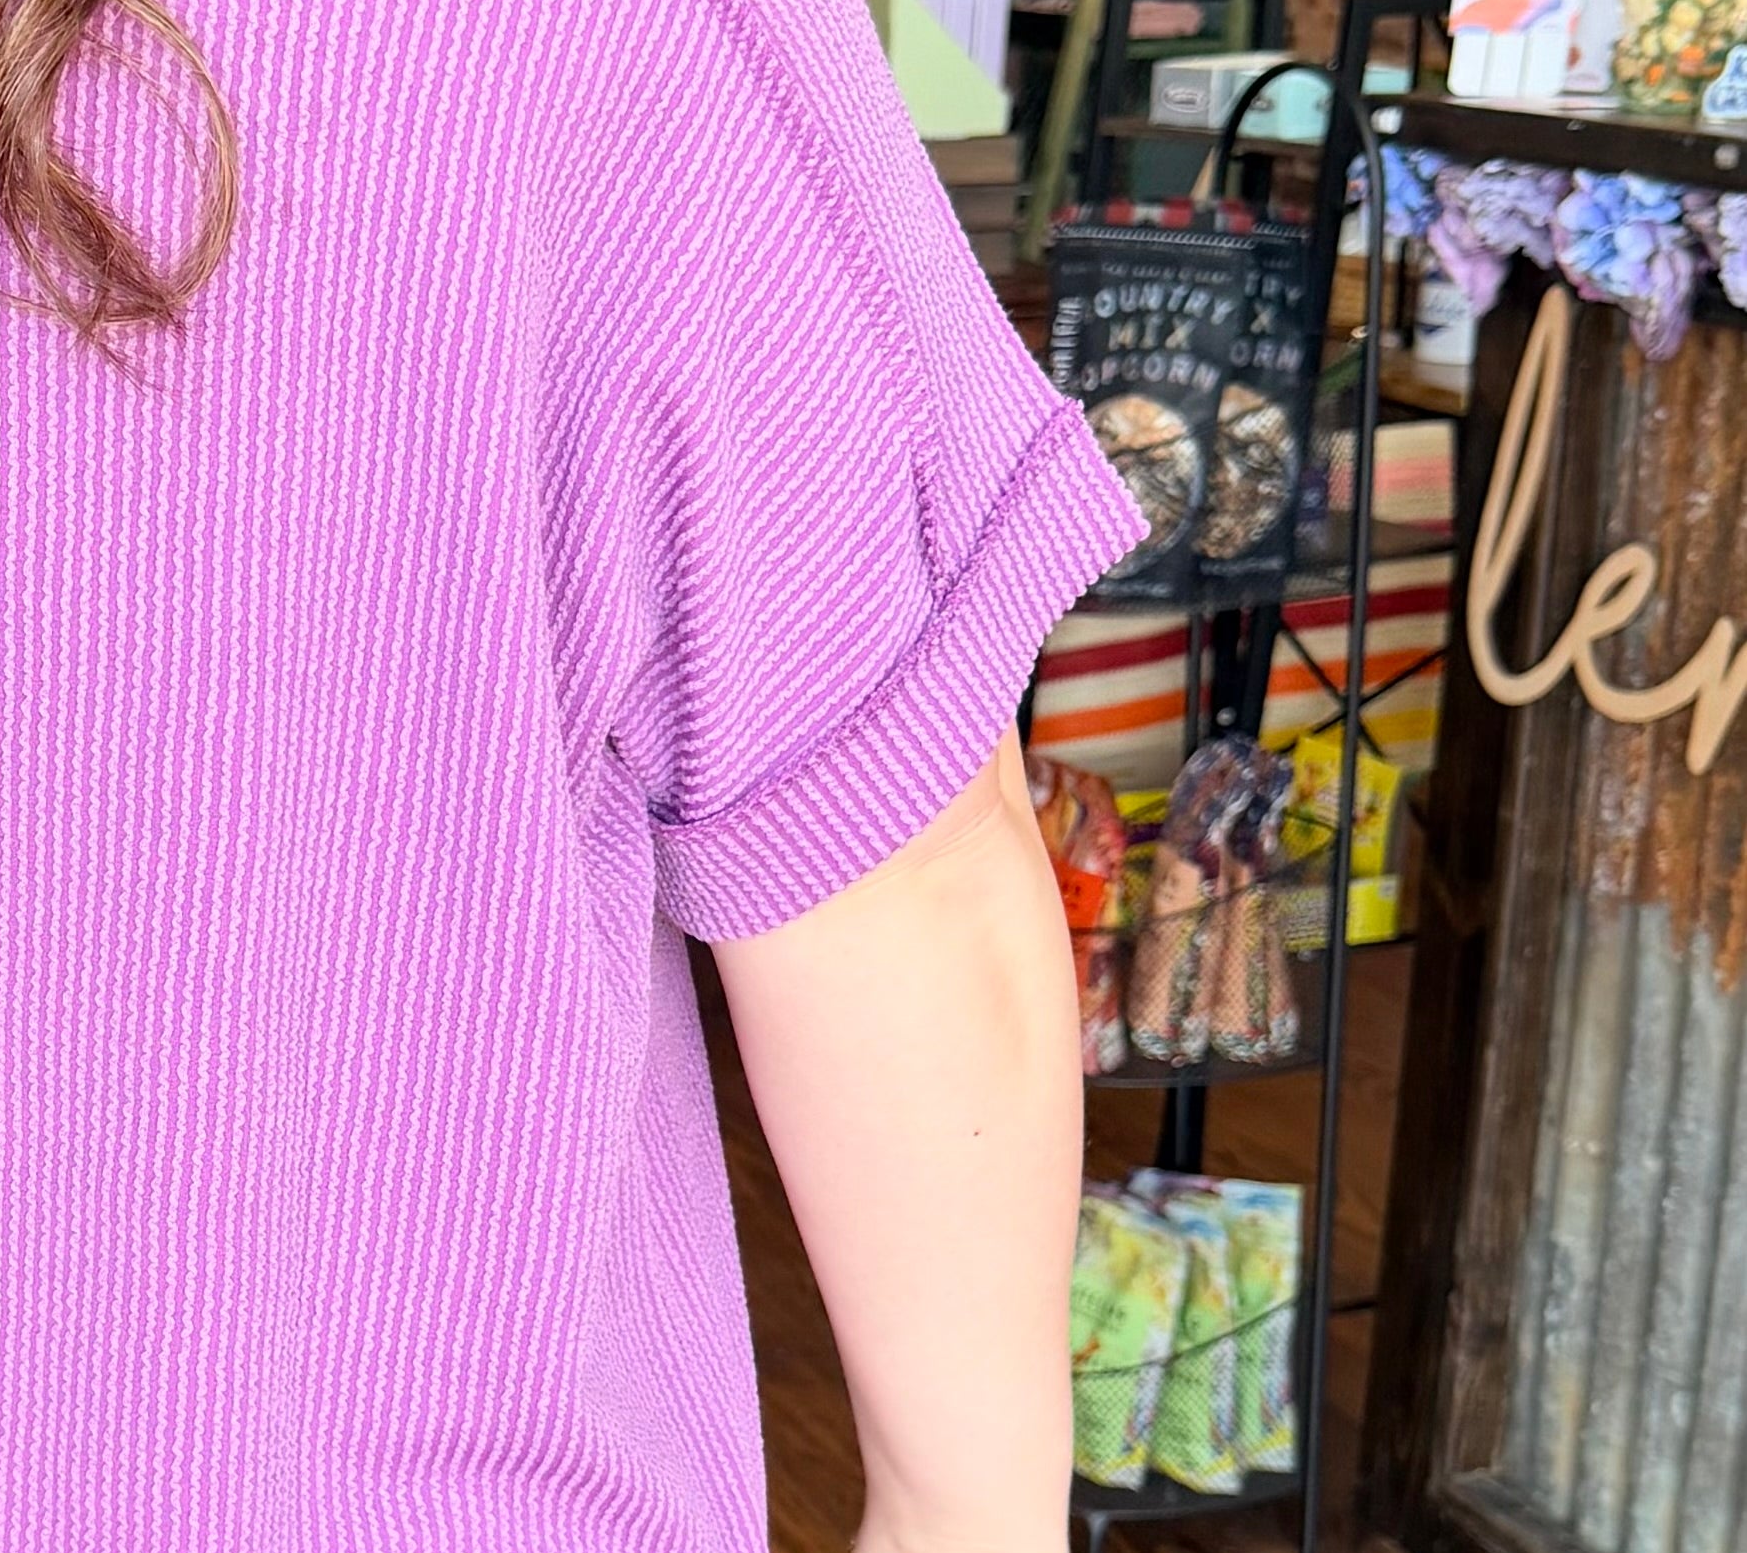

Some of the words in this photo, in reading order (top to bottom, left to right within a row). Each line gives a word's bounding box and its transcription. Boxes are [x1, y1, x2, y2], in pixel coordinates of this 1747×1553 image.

[1084, 280, 1236, 326] OUNTRY
[1108, 311, 1197, 352] MIX
[1071, 349, 1222, 394] OPCORN
